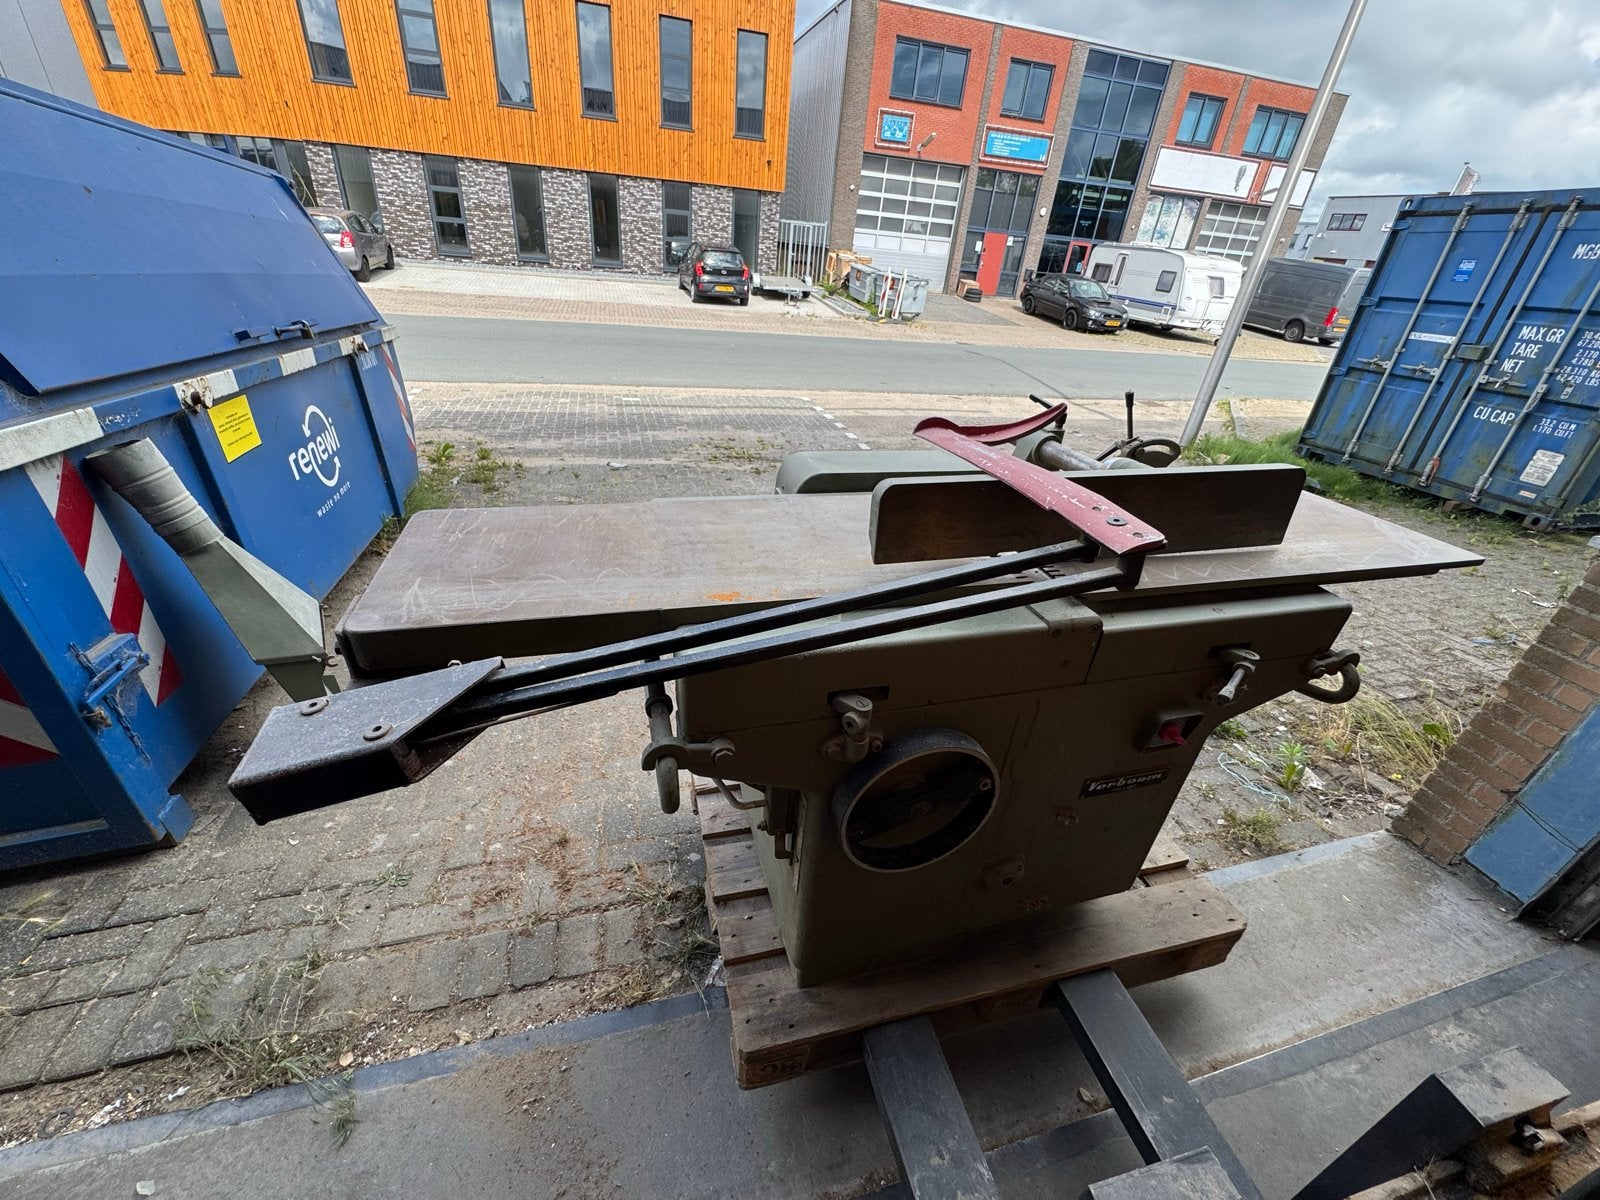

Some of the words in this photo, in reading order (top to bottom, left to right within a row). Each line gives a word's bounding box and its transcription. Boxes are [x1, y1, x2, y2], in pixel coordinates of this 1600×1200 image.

[1511, 342, 1543, 358] TARE
[1500, 358, 1525, 373] NET
[288, 416, 341, 484] renewi
[316, 498, 334, 518] waste
[333, 492, 341, 503] no
[339, 480, 351, 496] more
[1088, 773, 1163, 792] Verboom
